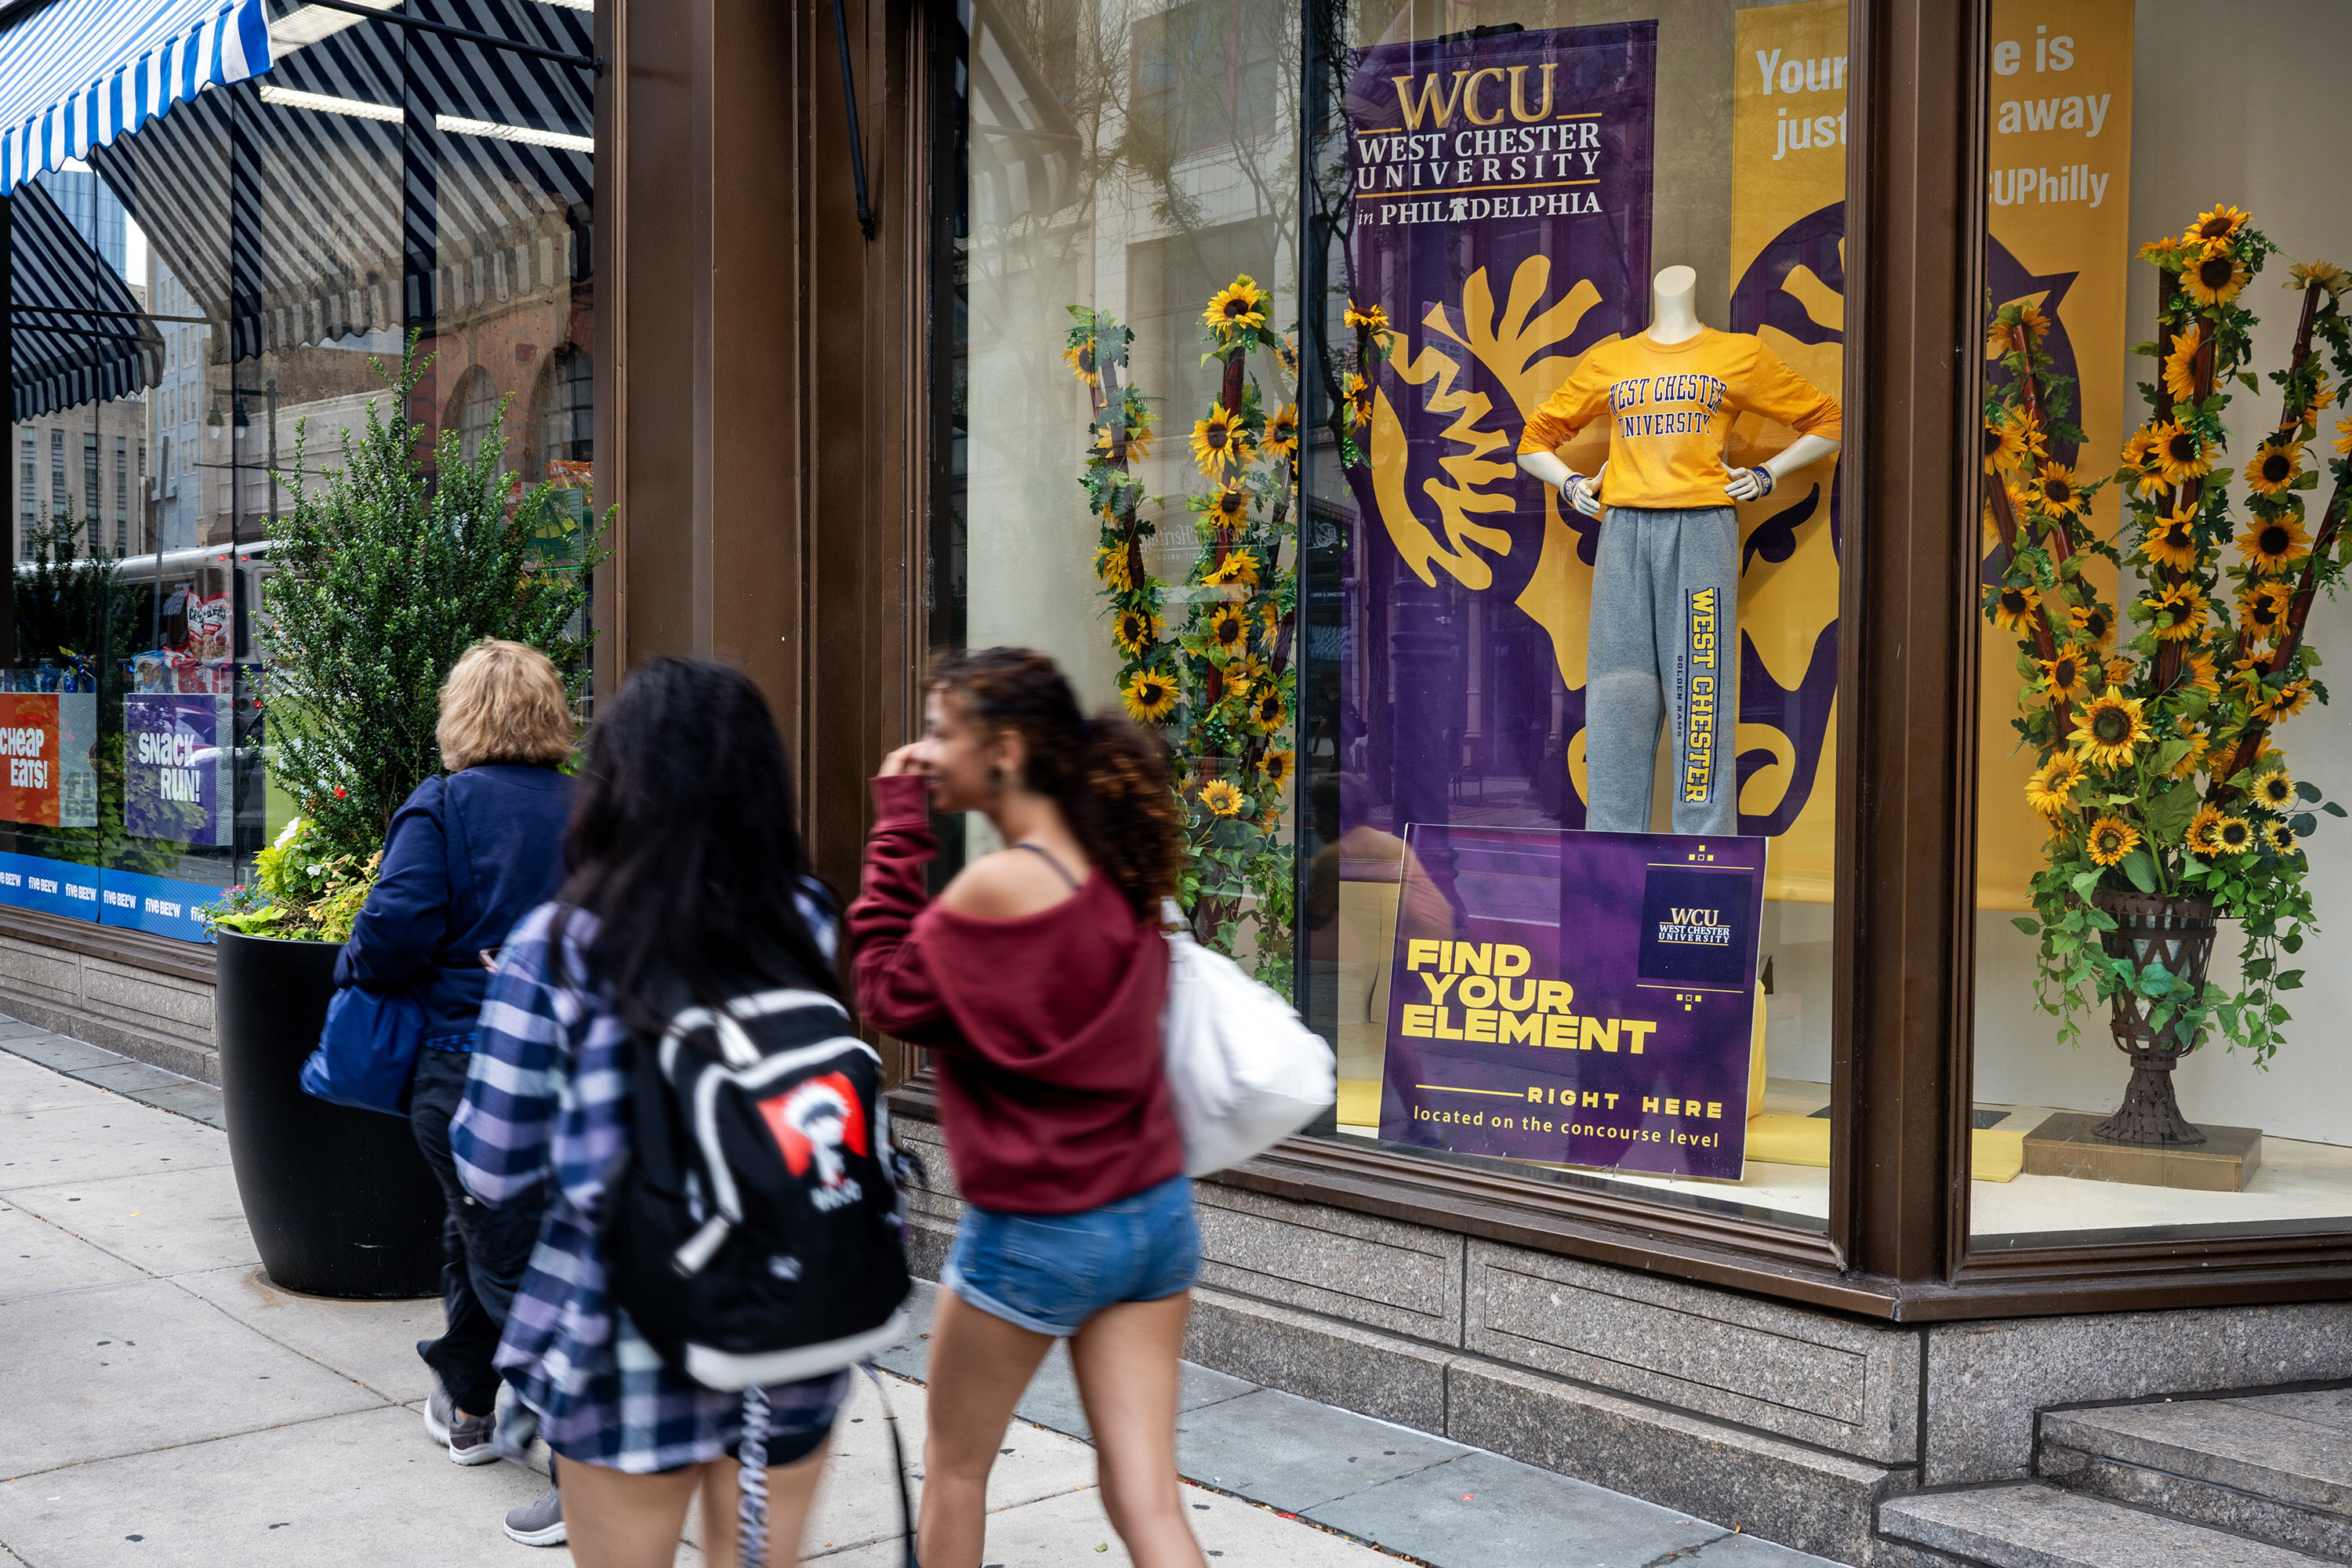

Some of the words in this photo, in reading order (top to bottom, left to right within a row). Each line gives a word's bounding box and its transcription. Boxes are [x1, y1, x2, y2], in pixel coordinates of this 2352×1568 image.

[1755, 49, 1847, 95] Your
[1991, 40, 2020, 75] e
[2036, 24, 2074, 72] is
[1392, 63, 1558, 130] WCU
[1358, 133, 1446, 164] WEST
[1454, 122, 1601, 156] CHESTER
[1773, 107, 1846, 160] just
[1998, 93, 2111, 137] away
[1358, 151, 1600, 190] UNIVERSITY
[1989, 164, 2109, 208] UPhilly
[1359, 209, 1374, 225] in
[1609, 378, 1650, 416] WEST
[1654, 375, 1727, 415] CHESTER
[1690, 586, 1715, 669] WEST
[1685, 676, 1715, 803] CHESTER
[160, 768, 200, 803] RUN!
[29, 877, 40, 891] five
[65, 883, 78, 898] five
[103, 890, 117, 906] five
[145, 898, 159, 914] five
[1671, 908, 1719, 927] WCU
[1658, 932, 1730, 943] UNIVERSITY
[1659, 924, 1686, 934] WEST
[1687, 926, 1730, 936] CHESTER
[1406, 938, 1531, 978] FIND
[1419, 972, 1573, 1014] YOUR
[1401, 1004, 1657, 1054] ELEMENT
[1528, 1087, 1619, 1109] RIGHT
[1642, 1096, 1722, 1119] HERE
[1414, 1105, 1483, 1126] located
[1491, 1116, 1513, 1129] on
[1522, 1116, 1552, 1132] the
[1560, 1123, 1661, 1142] concourse
[1670, 1129, 1719, 1148] level
